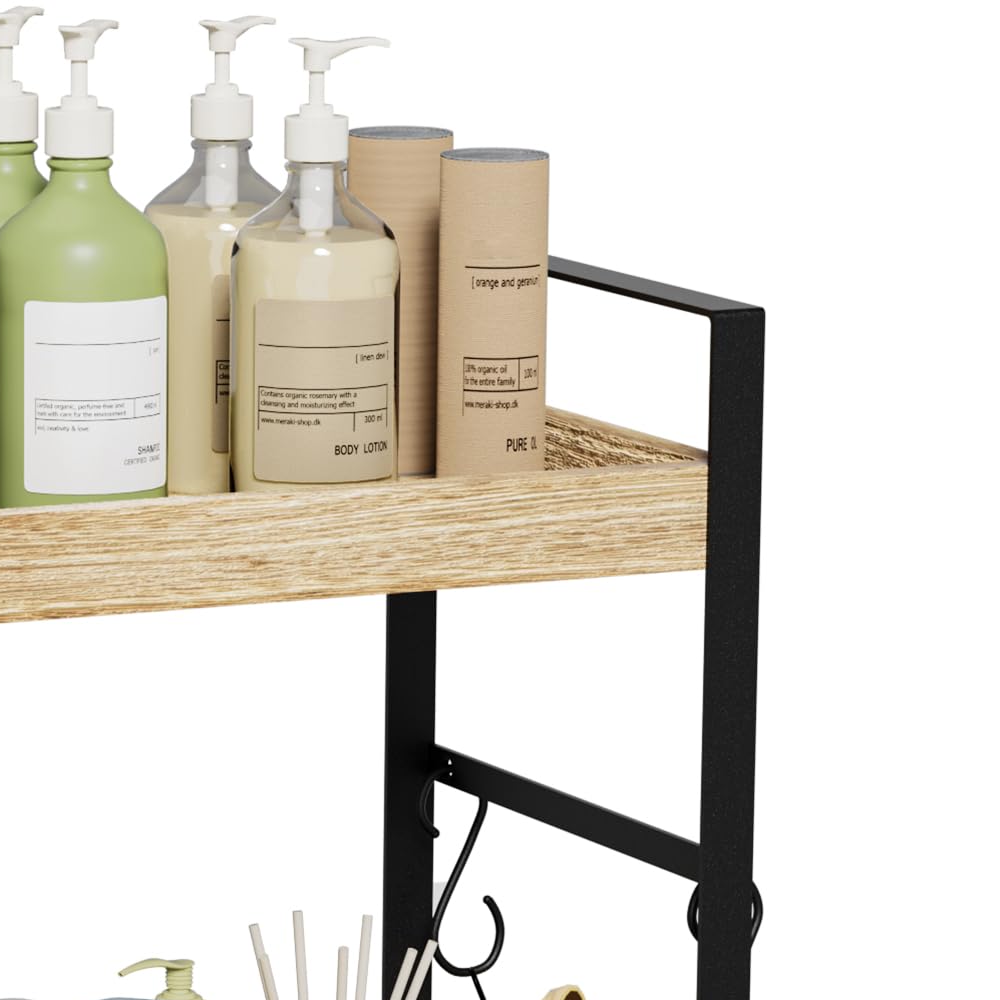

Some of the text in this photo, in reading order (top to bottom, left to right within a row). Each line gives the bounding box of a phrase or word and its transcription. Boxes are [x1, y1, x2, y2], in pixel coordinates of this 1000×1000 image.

[501, 277, 515, 287] and
[479, 378, 496, 386] entire
[496, 376, 516, 387] family
[260, 390, 284, 398] Contains
[285, 392, 307, 400] organic
[340, 391, 351, 399] with
[334, 440, 388, 456] BODY LOTION
[506, 436, 527, 452] PURE
